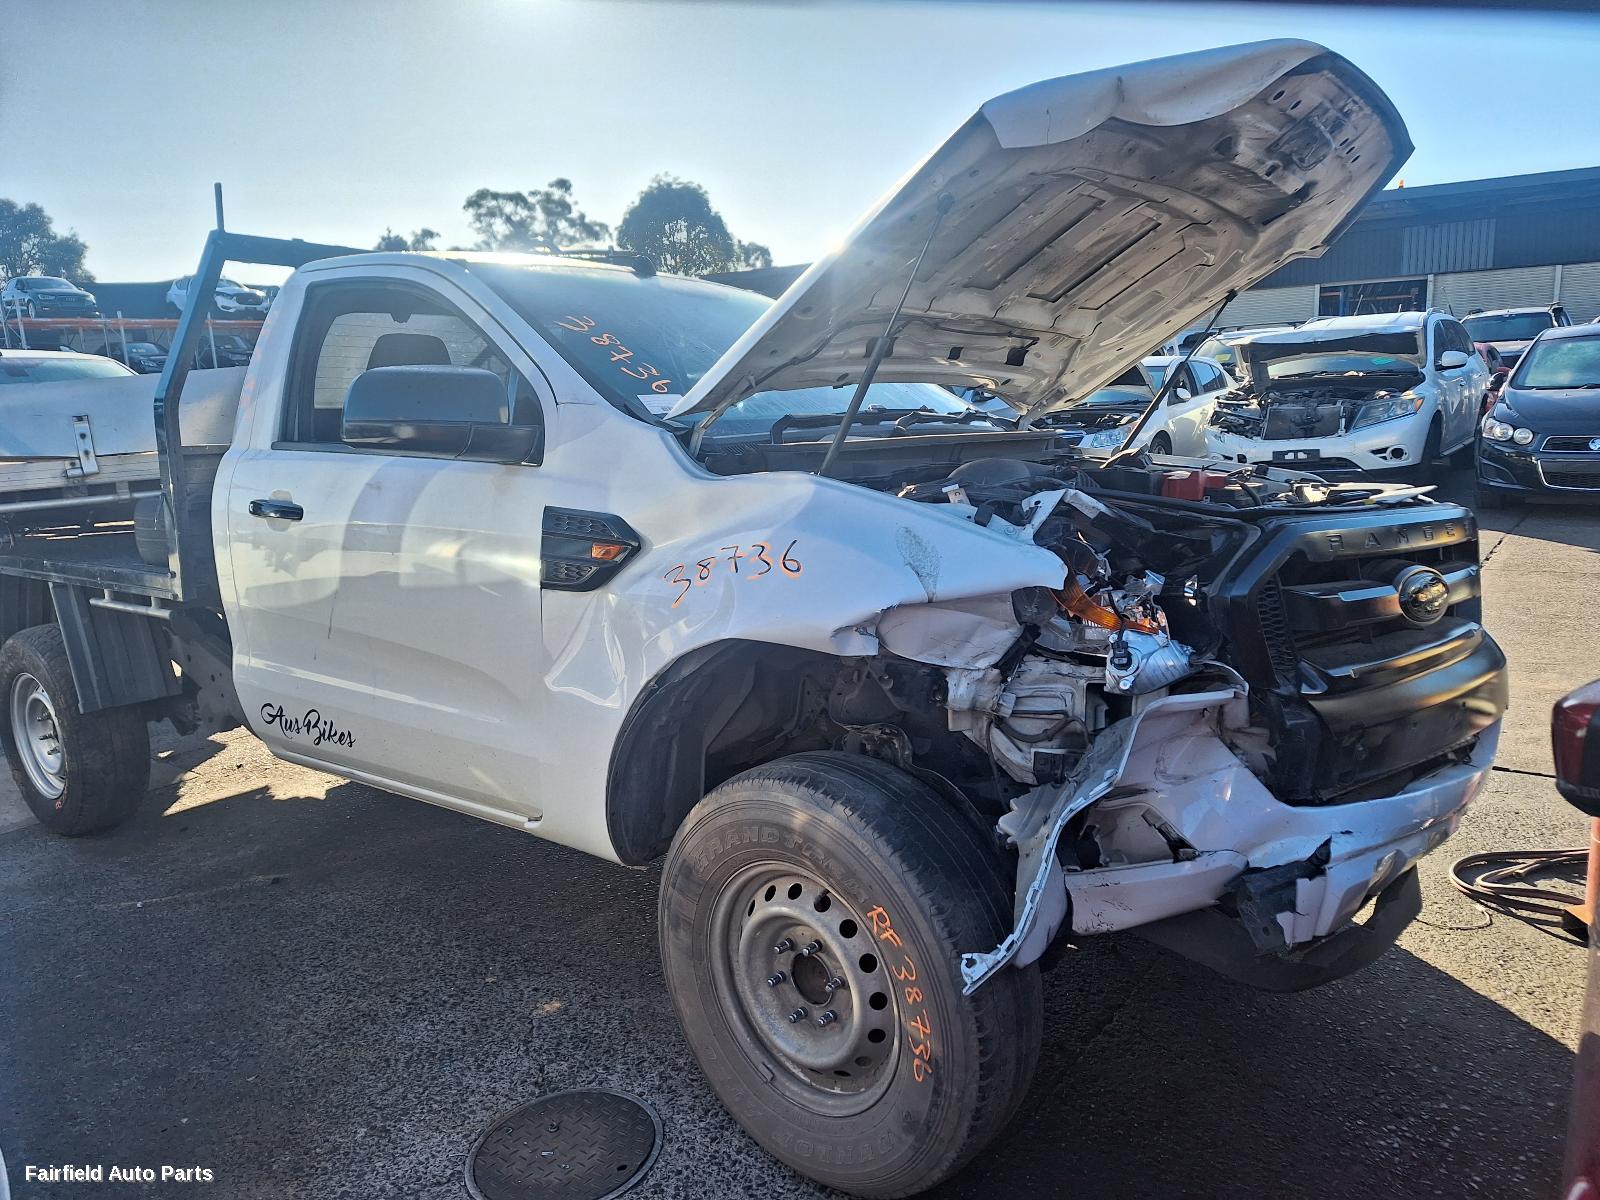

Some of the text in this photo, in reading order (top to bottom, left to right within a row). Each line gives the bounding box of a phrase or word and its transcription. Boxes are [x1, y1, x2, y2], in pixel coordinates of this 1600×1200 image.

[553, 315, 671, 393] 38736
[663, 540, 803, 609] 38736
[867, 904, 932, 1082] RF 38736
